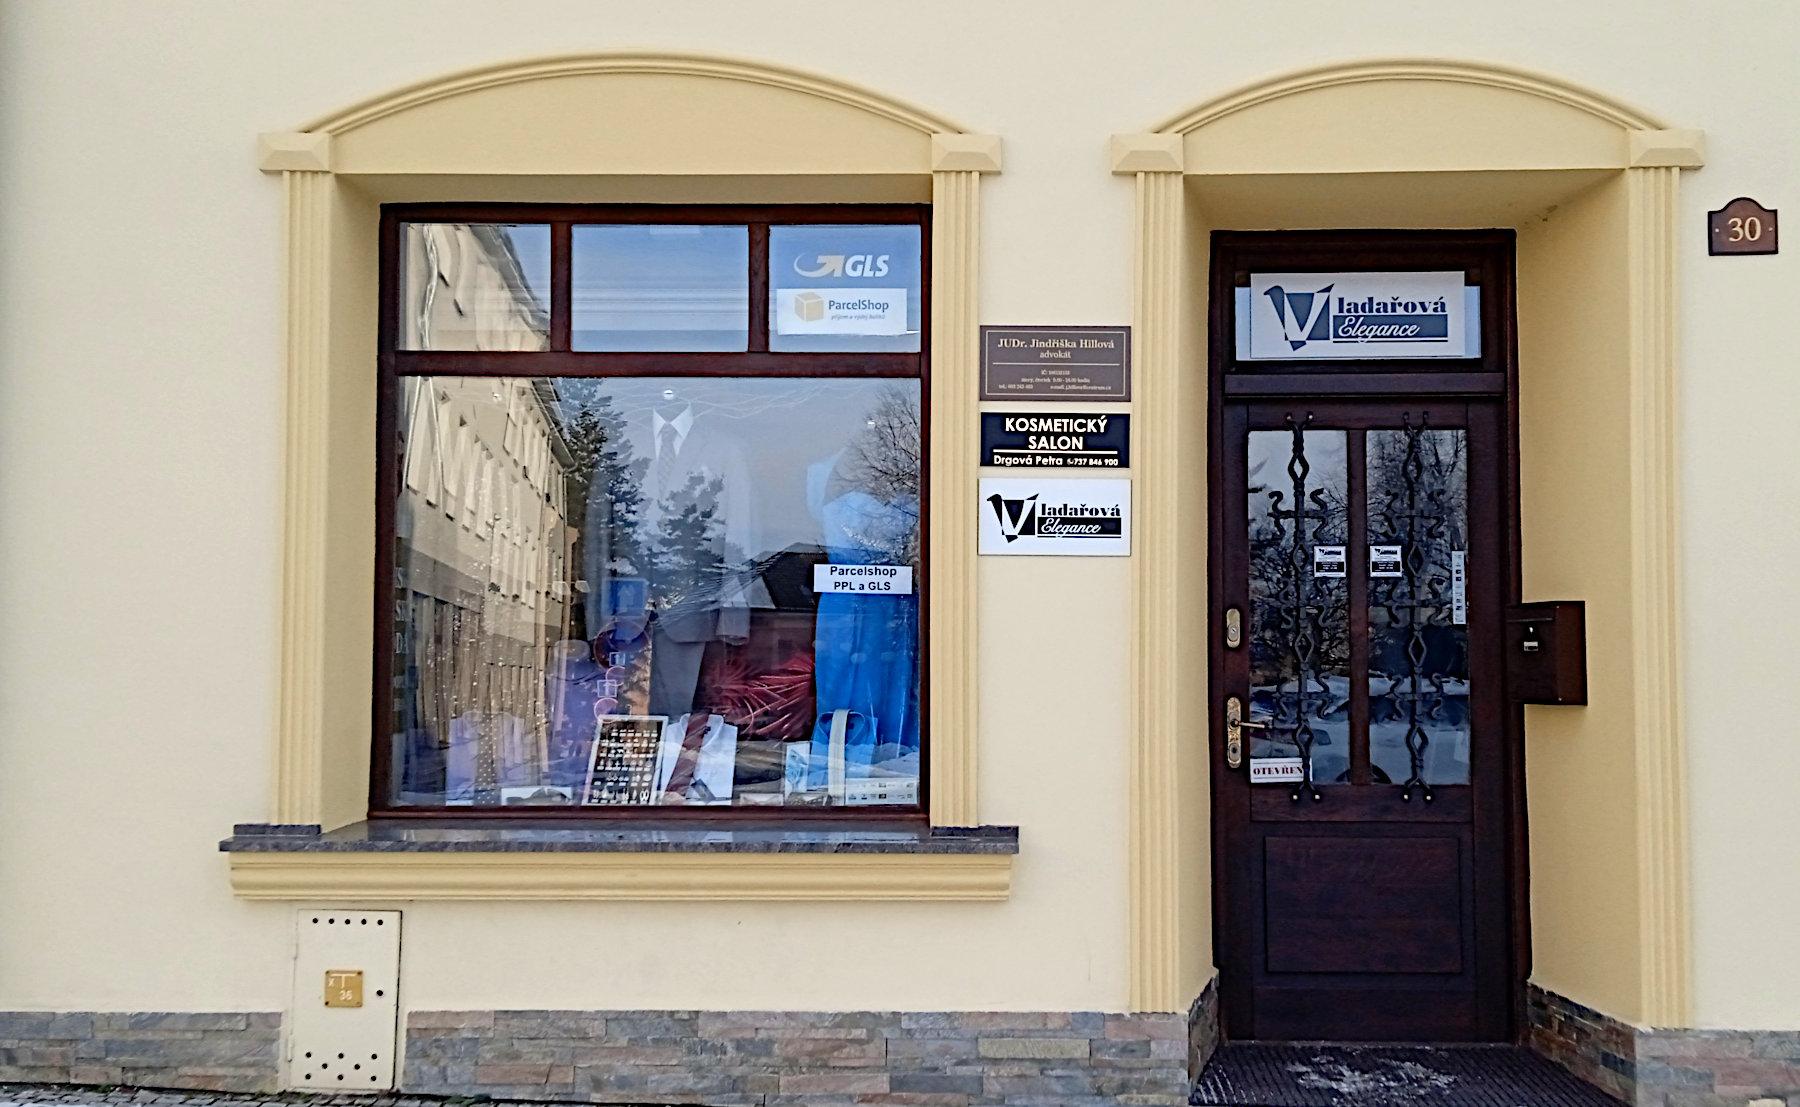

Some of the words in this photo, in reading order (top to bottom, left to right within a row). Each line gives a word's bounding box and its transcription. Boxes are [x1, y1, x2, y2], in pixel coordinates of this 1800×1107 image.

[1728, 216, 1762, 242] 30
[845, 254, 890, 278] GLS
[828, 299, 889, 313] ParcelShop
[1337, 315, 1420, 343] Elegance
[998, 338, 1028, 348] JUDr.
[1029, 338, 1077, 348] Jindřiška
[1079, 338, 1115, 349] Hillová
[1039, 350, 1072, 359] advokát
[1005, 415, 1108, 433] KOSMETICKÝ
[1028, 435, 1084, 450] SALON
[993, 455, 1033, 466] Drgová
[1035, 455, 1063, 466] Petra
[1073, 457, 1088, 466] 737
[1040, 517, 1102, 538] Elegance
[830, 565, 897, 578] Parcelshop
[833, 581, 855, 591] PPL
[858, 583, 865, 591] a
[868, 581, 891, 591] GLS
